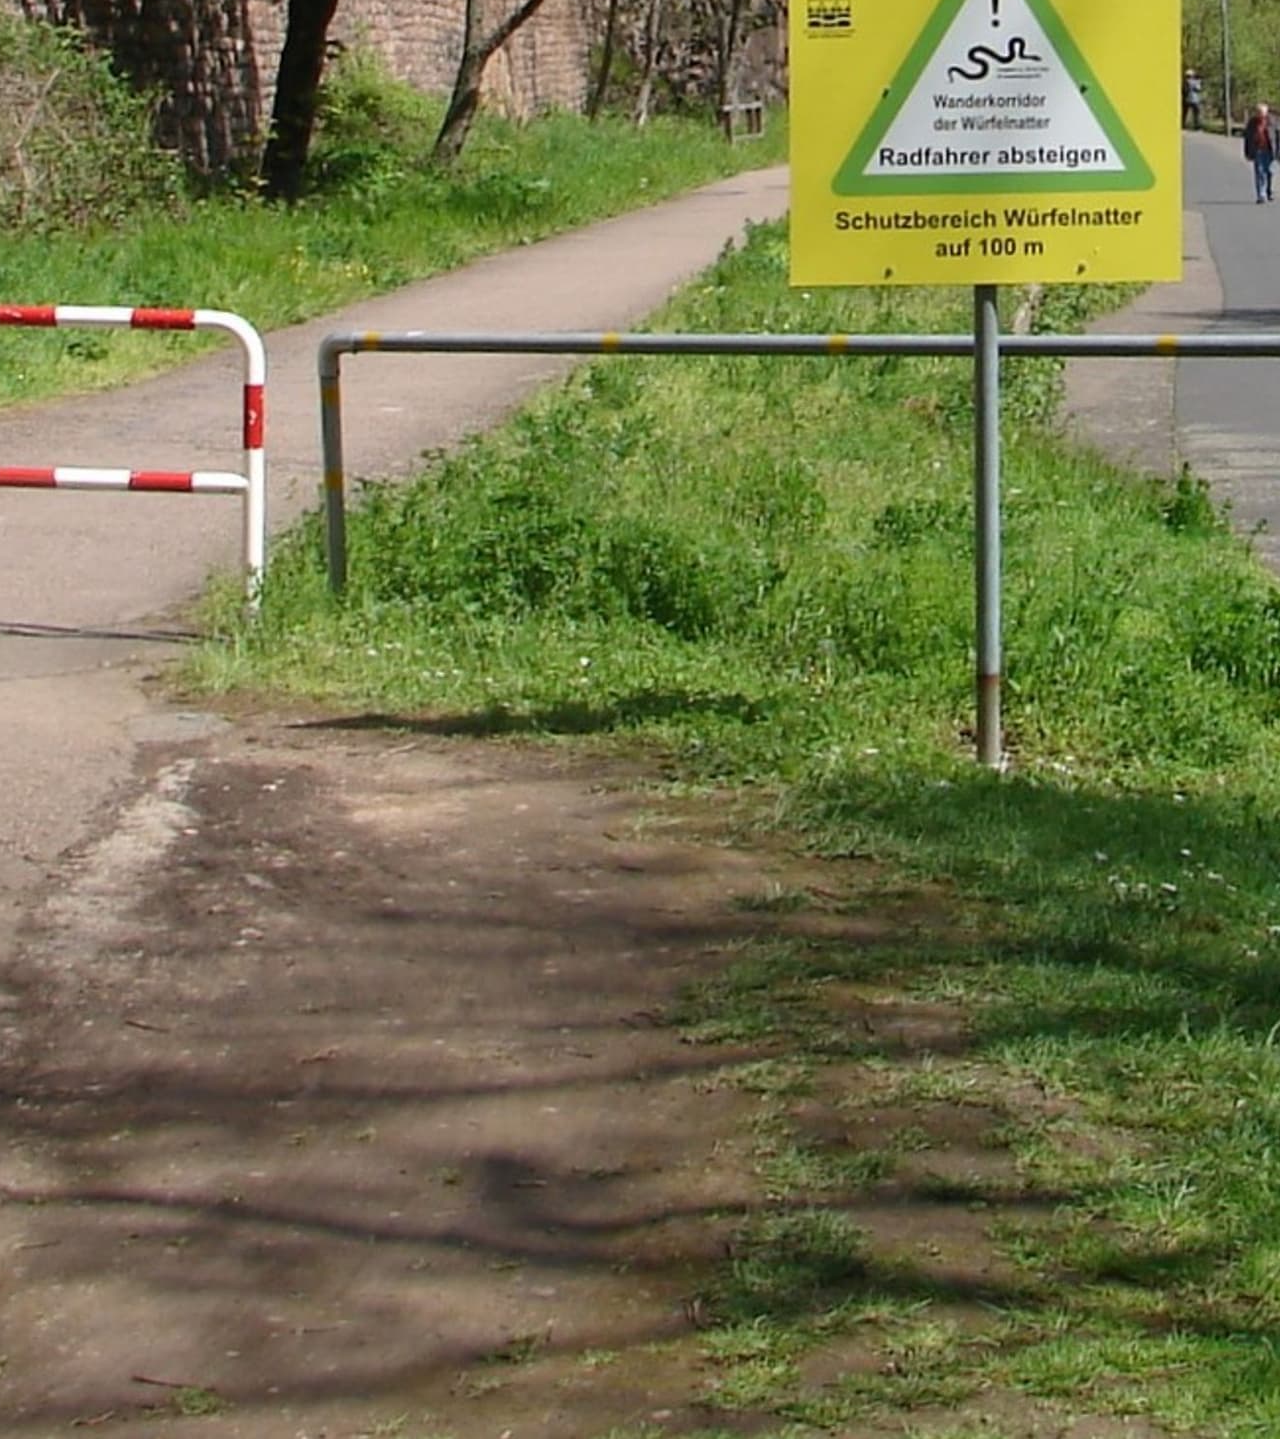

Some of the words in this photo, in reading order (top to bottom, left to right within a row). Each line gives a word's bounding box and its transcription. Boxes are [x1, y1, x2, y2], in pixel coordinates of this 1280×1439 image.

[932, 93, 1047, 109] Wanderkorridor
[933, 117, 958, 131] der
[961, 114, 1052, 131] Würfelnatter
[879, 147, 991, 166] Radfahrer
[997, 145, 1107, 168] absteigen
[834, 209, 998, 230] Schutzbereich
[1003, 207, 1143, 228] Würfelnatter
[935, 238, 971, 257] auf
[979, 237, 1017, 256] 100
[1023, 241, 1045, 256] m
